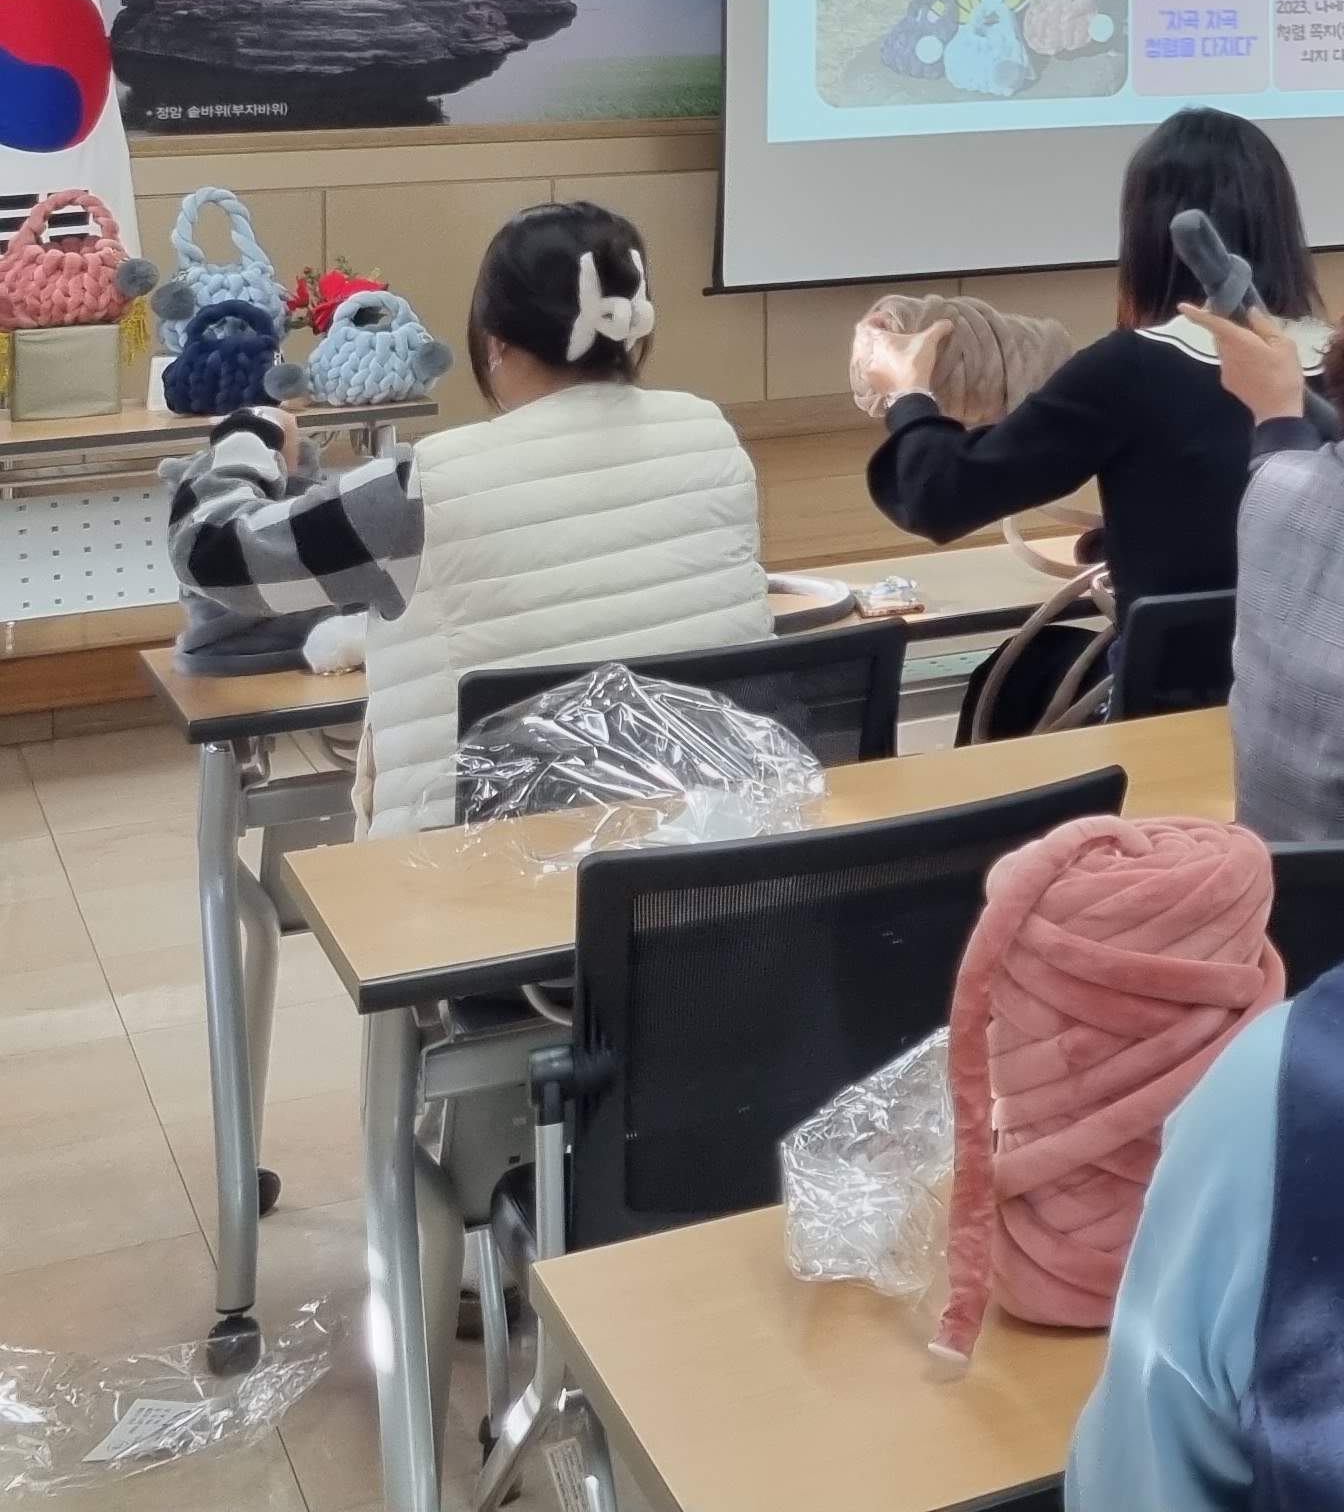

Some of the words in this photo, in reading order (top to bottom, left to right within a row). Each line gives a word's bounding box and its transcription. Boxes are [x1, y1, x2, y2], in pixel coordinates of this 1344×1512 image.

[1277, 22, 1306, 41] 청렴
[1300, 48, 1328, 63] 의지
[156, 106, 182, 120] 정암
